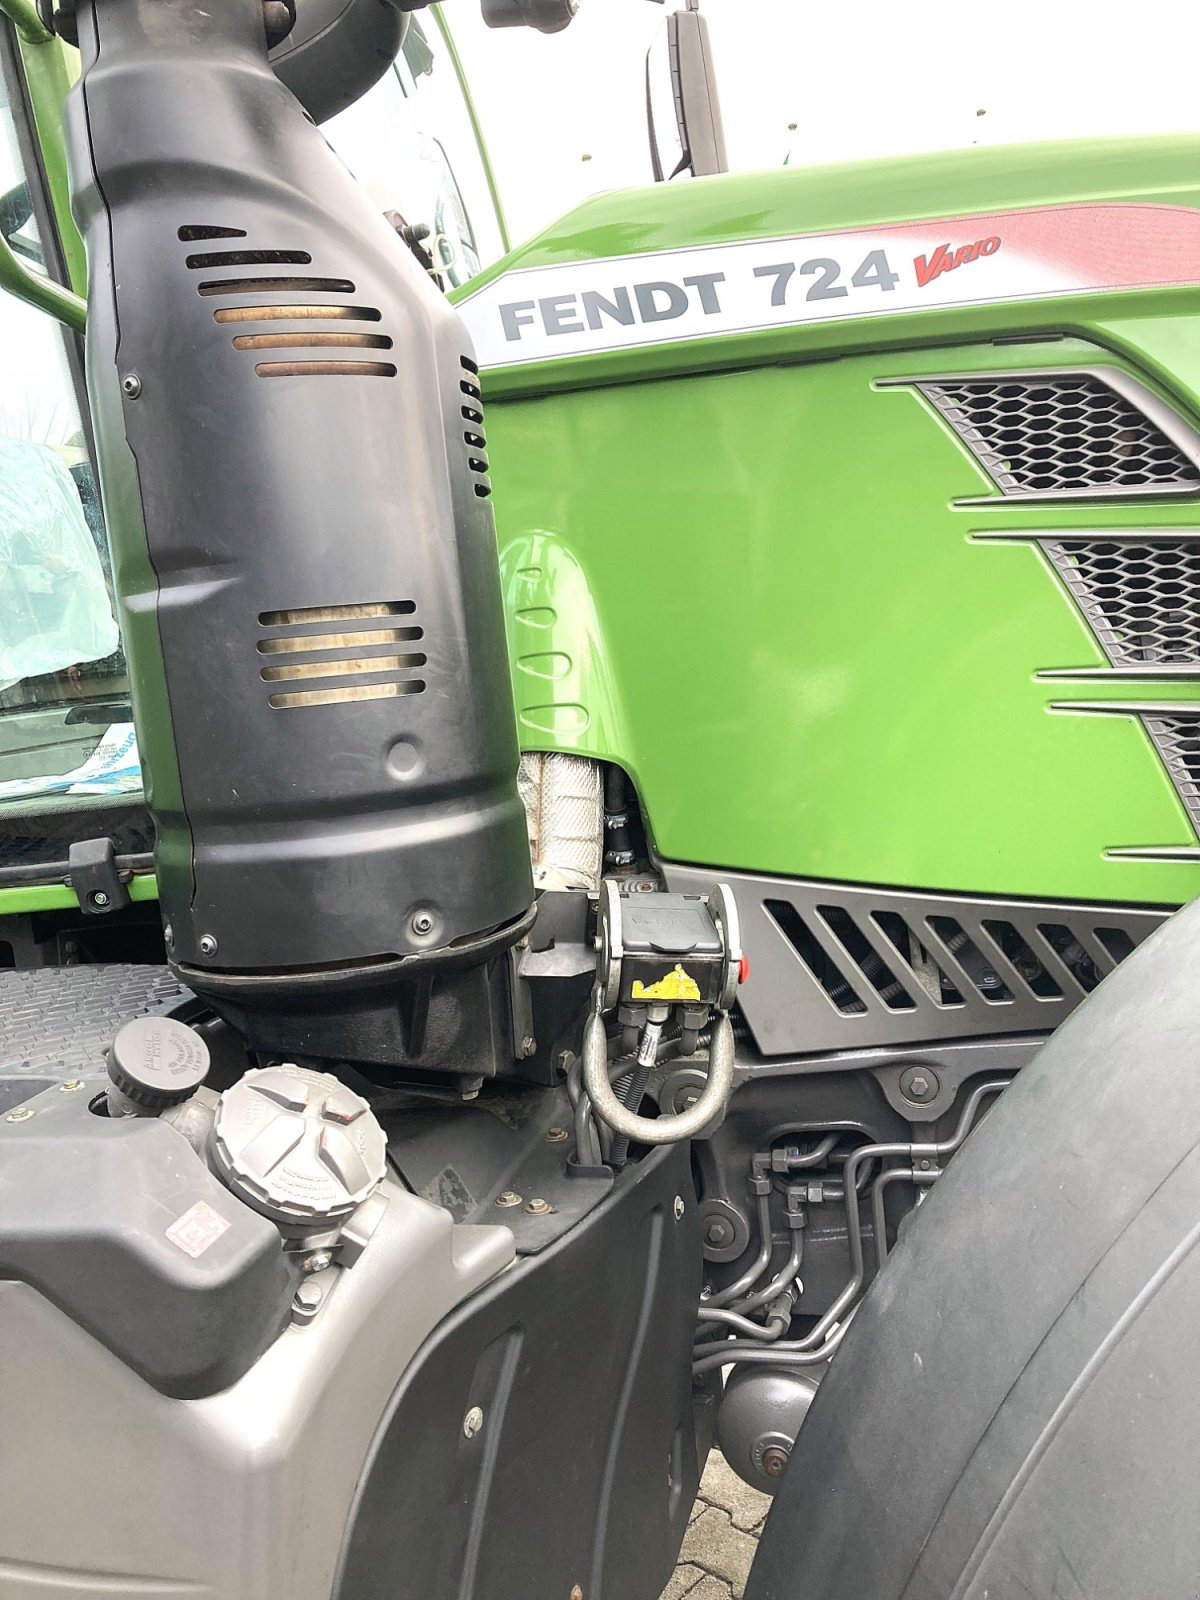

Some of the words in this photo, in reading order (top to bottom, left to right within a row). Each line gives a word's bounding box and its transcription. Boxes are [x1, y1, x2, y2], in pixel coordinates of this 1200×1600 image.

[498, 272, 726, 342] FENDT
[752, 248, 900, 307] 724
[913, 236, 1001, 288] VARIO
